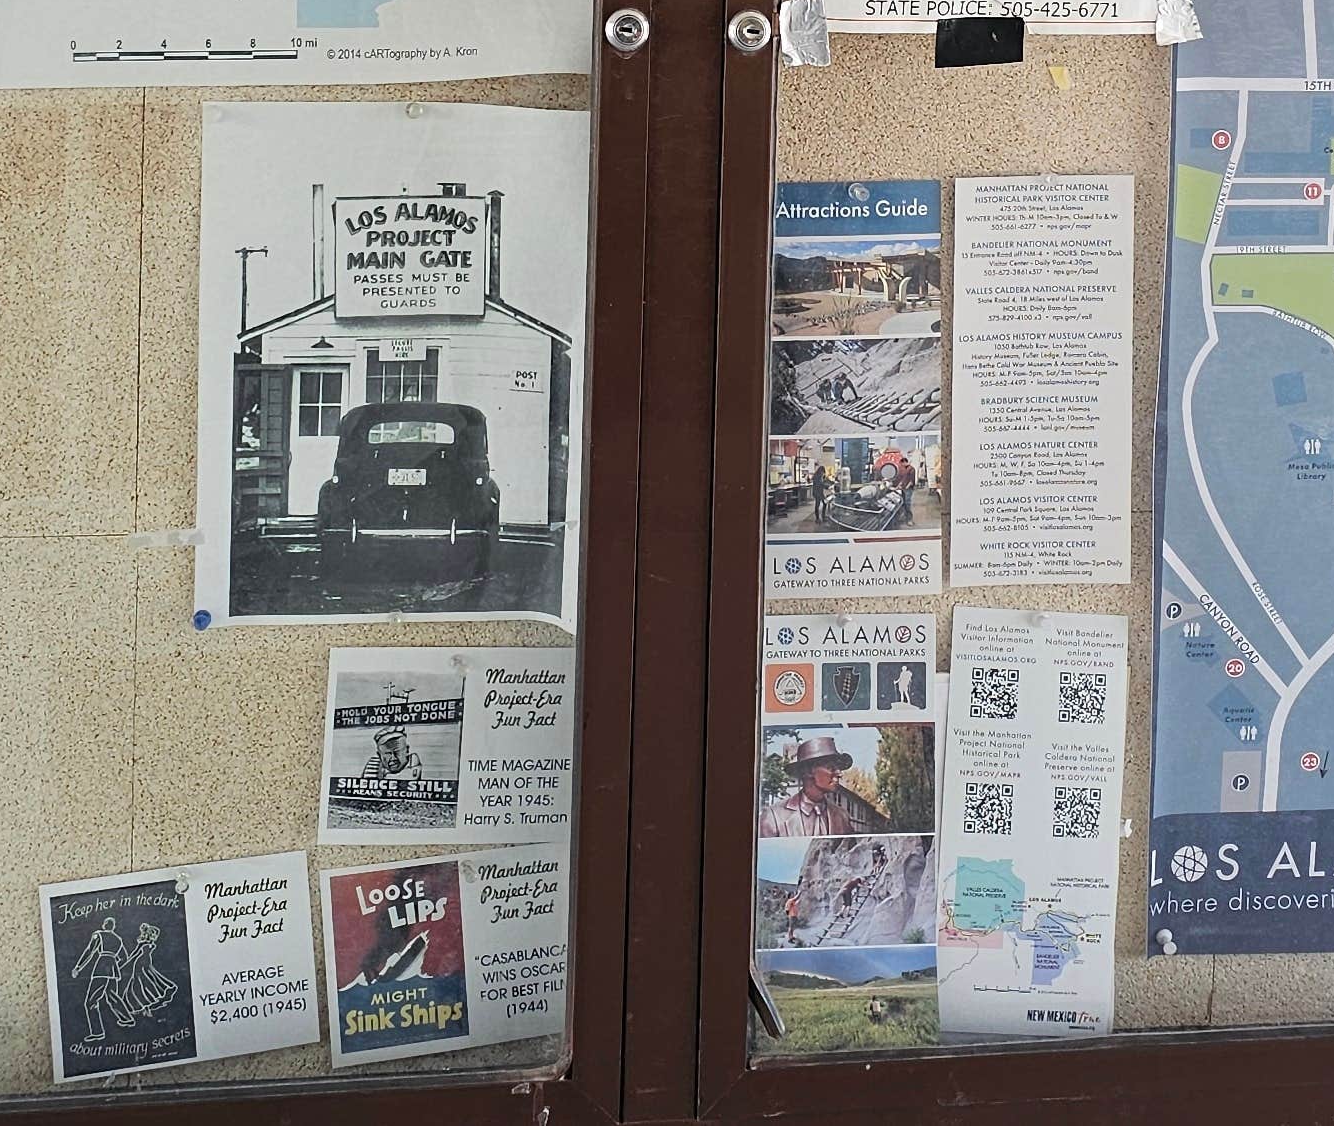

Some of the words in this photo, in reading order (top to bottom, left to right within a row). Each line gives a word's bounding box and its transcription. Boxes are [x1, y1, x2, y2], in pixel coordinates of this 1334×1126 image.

[776, 199, 869, 218] Attractions
[876, 198, 927, 216] Guide
[345, 206, 388, 236] LOS
[394, 203, 478, 234] ALAMOS
[366, 230, 457, 247] PROJECT
[347, 252, 405, 271] MAIN
[420, 251, 472, 269] GATE
[354, 274, 403, 284] PASSES
[412, 273, 447, 283] MUST
[456, 273, 469, 282] BE
[363, 286, 436, 296] PRESENTED
[445, 286, 460, 295] TO
[381, 299, 436, 308] GUARDS
[774, 557, 817, 574] LOS
[830, 553, 929, 573] ALAMOS
[774, 580, 815, 588] GATEWAY
[818, 579, 828, 587] TO
[859, 577, 901, 586] NATIONAL
[904, 576, 929, 584] PARKS
[468, 759, 497, 772] TIME
[502, 758, 570, 771] MAGAZINE
[478, 777, 509, 790] MAN
[514, 777, 532, 789] OF
[537, 777, 559, 788] THE
[480, 795, 512, 807] YEAR
[517, 795, 554, 806] 1945:
[1150, 843, 1239, 888] LOS
[204, 877, 288, 900] Manhattan
[356, 878, 425, 915] LOOSE
[207, 897, 287, 922] Project-Era
[388, 897, 448, 928] LIPS
[1150, 890, 1217, 916] where
[218, 925, 247, 943] Fun
[251, 918, 284, 938] Fact
[221, 966, 284, 986] AVERAGE
[199, 988, 245, 1006] YEARLY
[251, 980, 308, 999] INCOME
[371, 987, 427, 1005] MIGHT
[210, 1006, 258, 1025] $2,400
[263, 999, 307, 1019] (1945)
[345, 1009, 395, 1035] Sink
[401, 1000, 462, 1029] Ships
[1027, 1010, 1045, 1021] NEW
[1047, 1010, 1077, 1023] MEXICO
